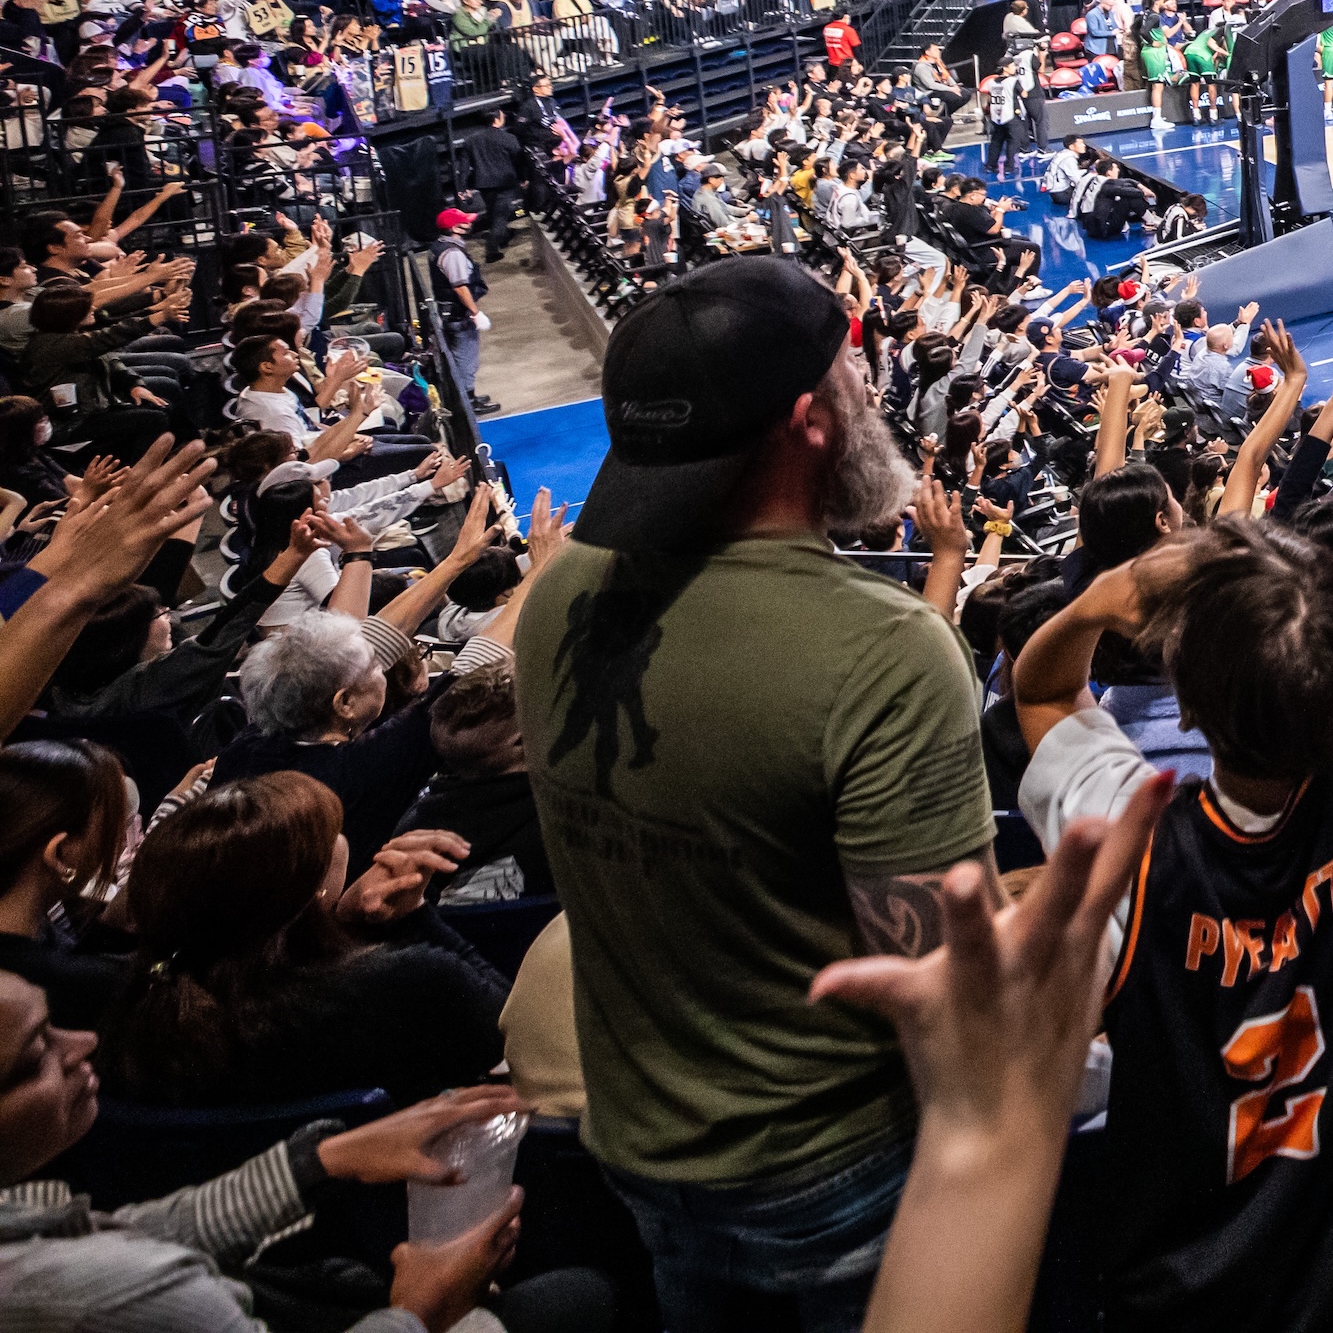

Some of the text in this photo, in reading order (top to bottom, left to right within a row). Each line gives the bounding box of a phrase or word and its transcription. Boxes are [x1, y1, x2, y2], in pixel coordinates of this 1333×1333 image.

[252, 6, 269, 23] 53
[399, 56, 416, 75] 15
[427, 50, 446, 72] 15
[1074, 110, 1111, 125] SPALDING
[1220, 984, 1327, 1186] 2
